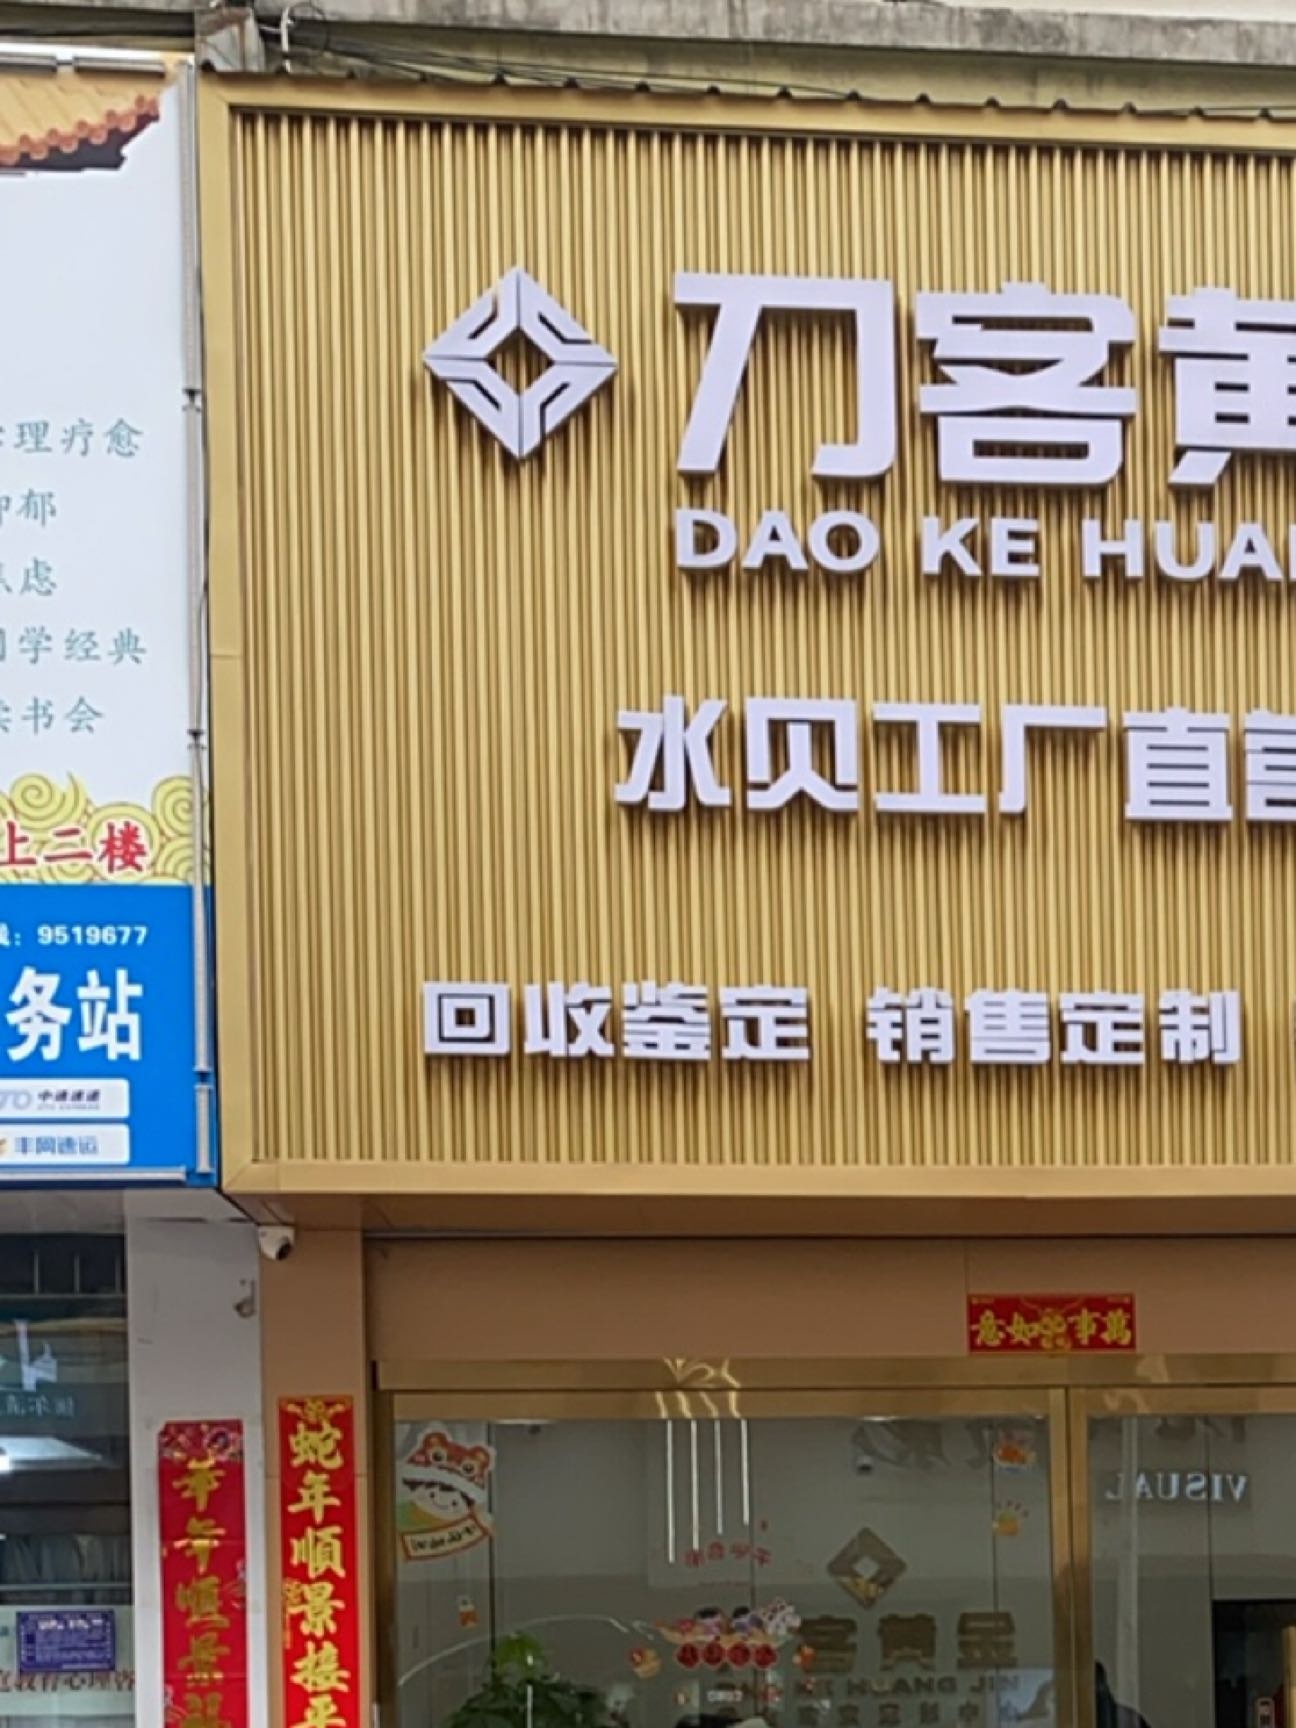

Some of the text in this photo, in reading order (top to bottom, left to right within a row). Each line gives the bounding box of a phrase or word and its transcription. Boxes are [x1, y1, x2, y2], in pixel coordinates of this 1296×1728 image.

[0, 418, 143, 457] 理疗愈
[675, 508, 880, 575] DAO
[920, 514, 1044, 579] KE
[0, 626, 147, 665] 学经典
[423, 979, 811, 1065] 回收鉴定
[866, 986, 1243, 1069] 销售定制
